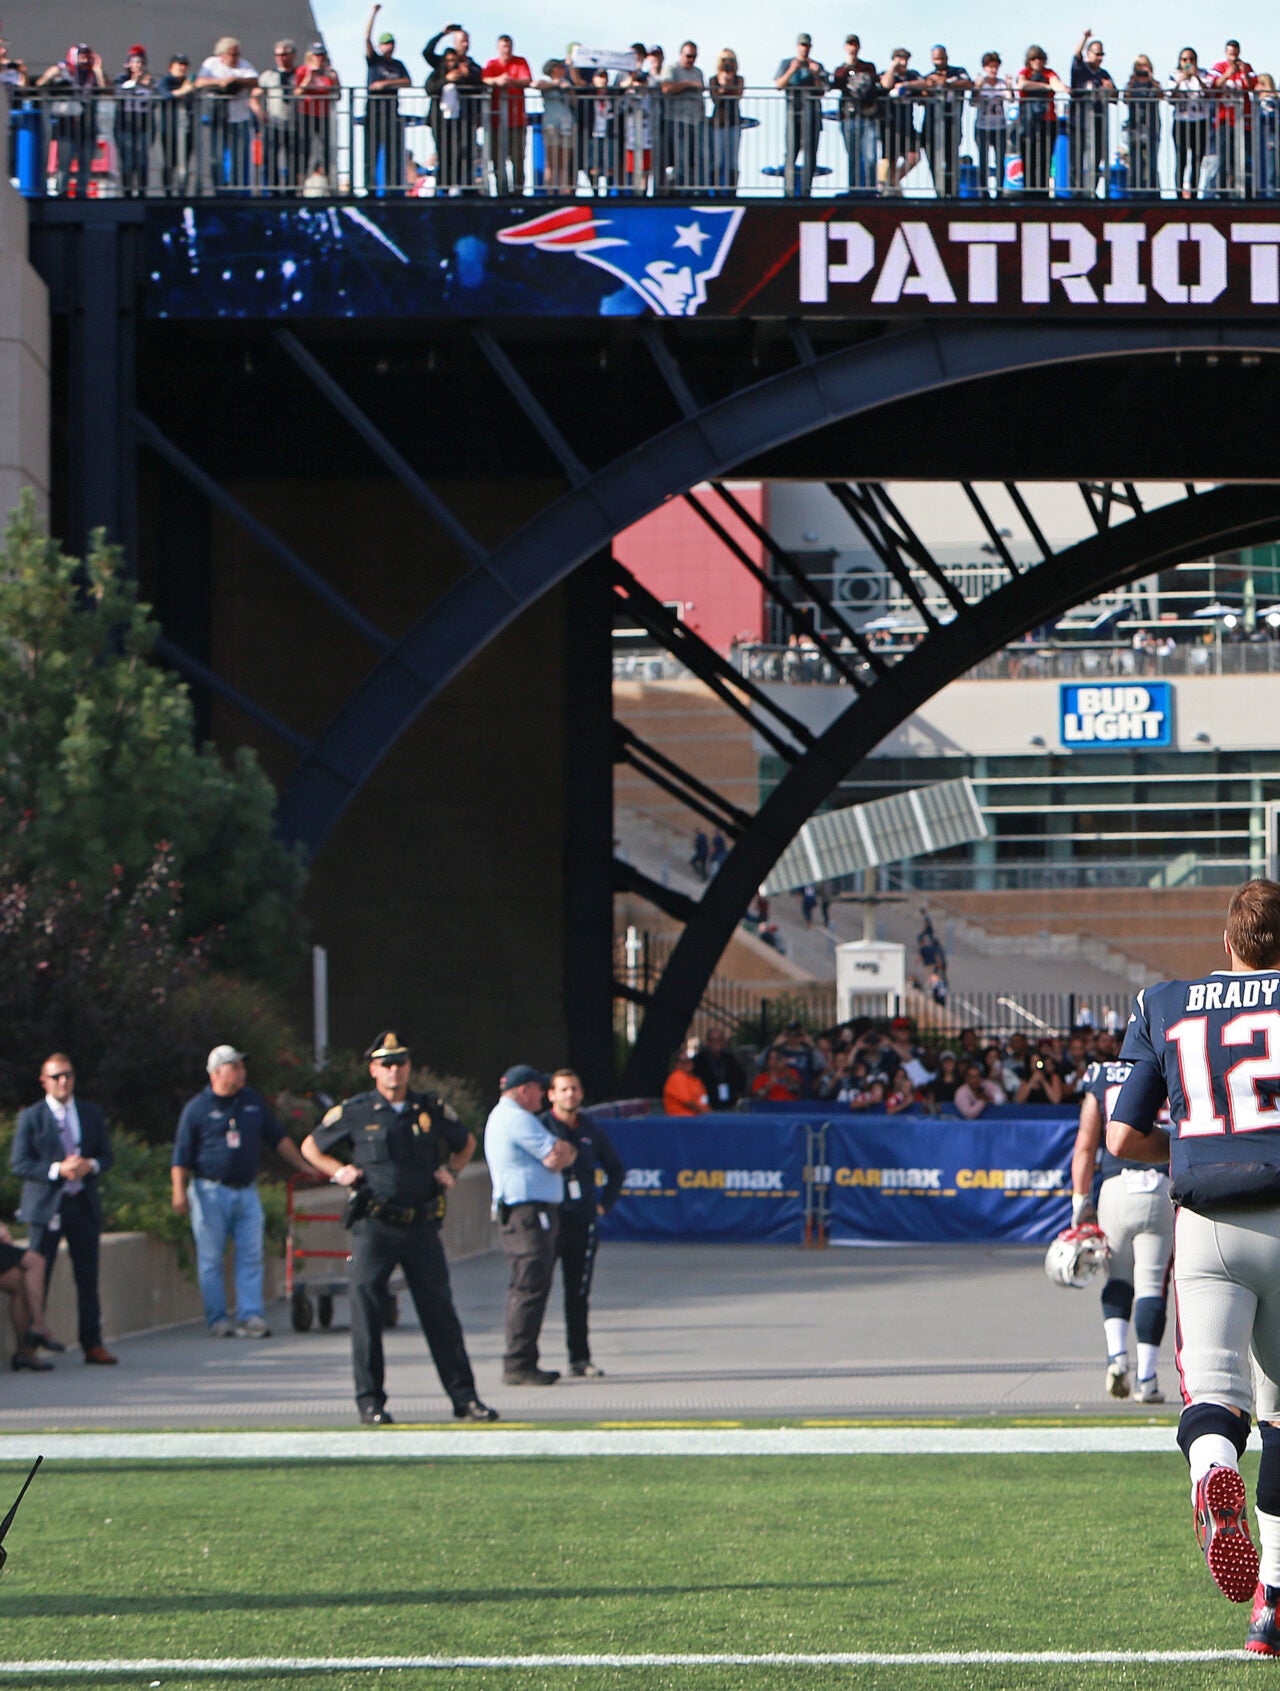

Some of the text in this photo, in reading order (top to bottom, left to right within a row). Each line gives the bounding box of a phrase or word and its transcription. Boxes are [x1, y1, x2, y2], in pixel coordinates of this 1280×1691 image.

[1077, 686, 1151, 714] BUD
[1064, 711, 1164, 741] LIGHT
[1186, 978, 1279, 1012] BRADY
